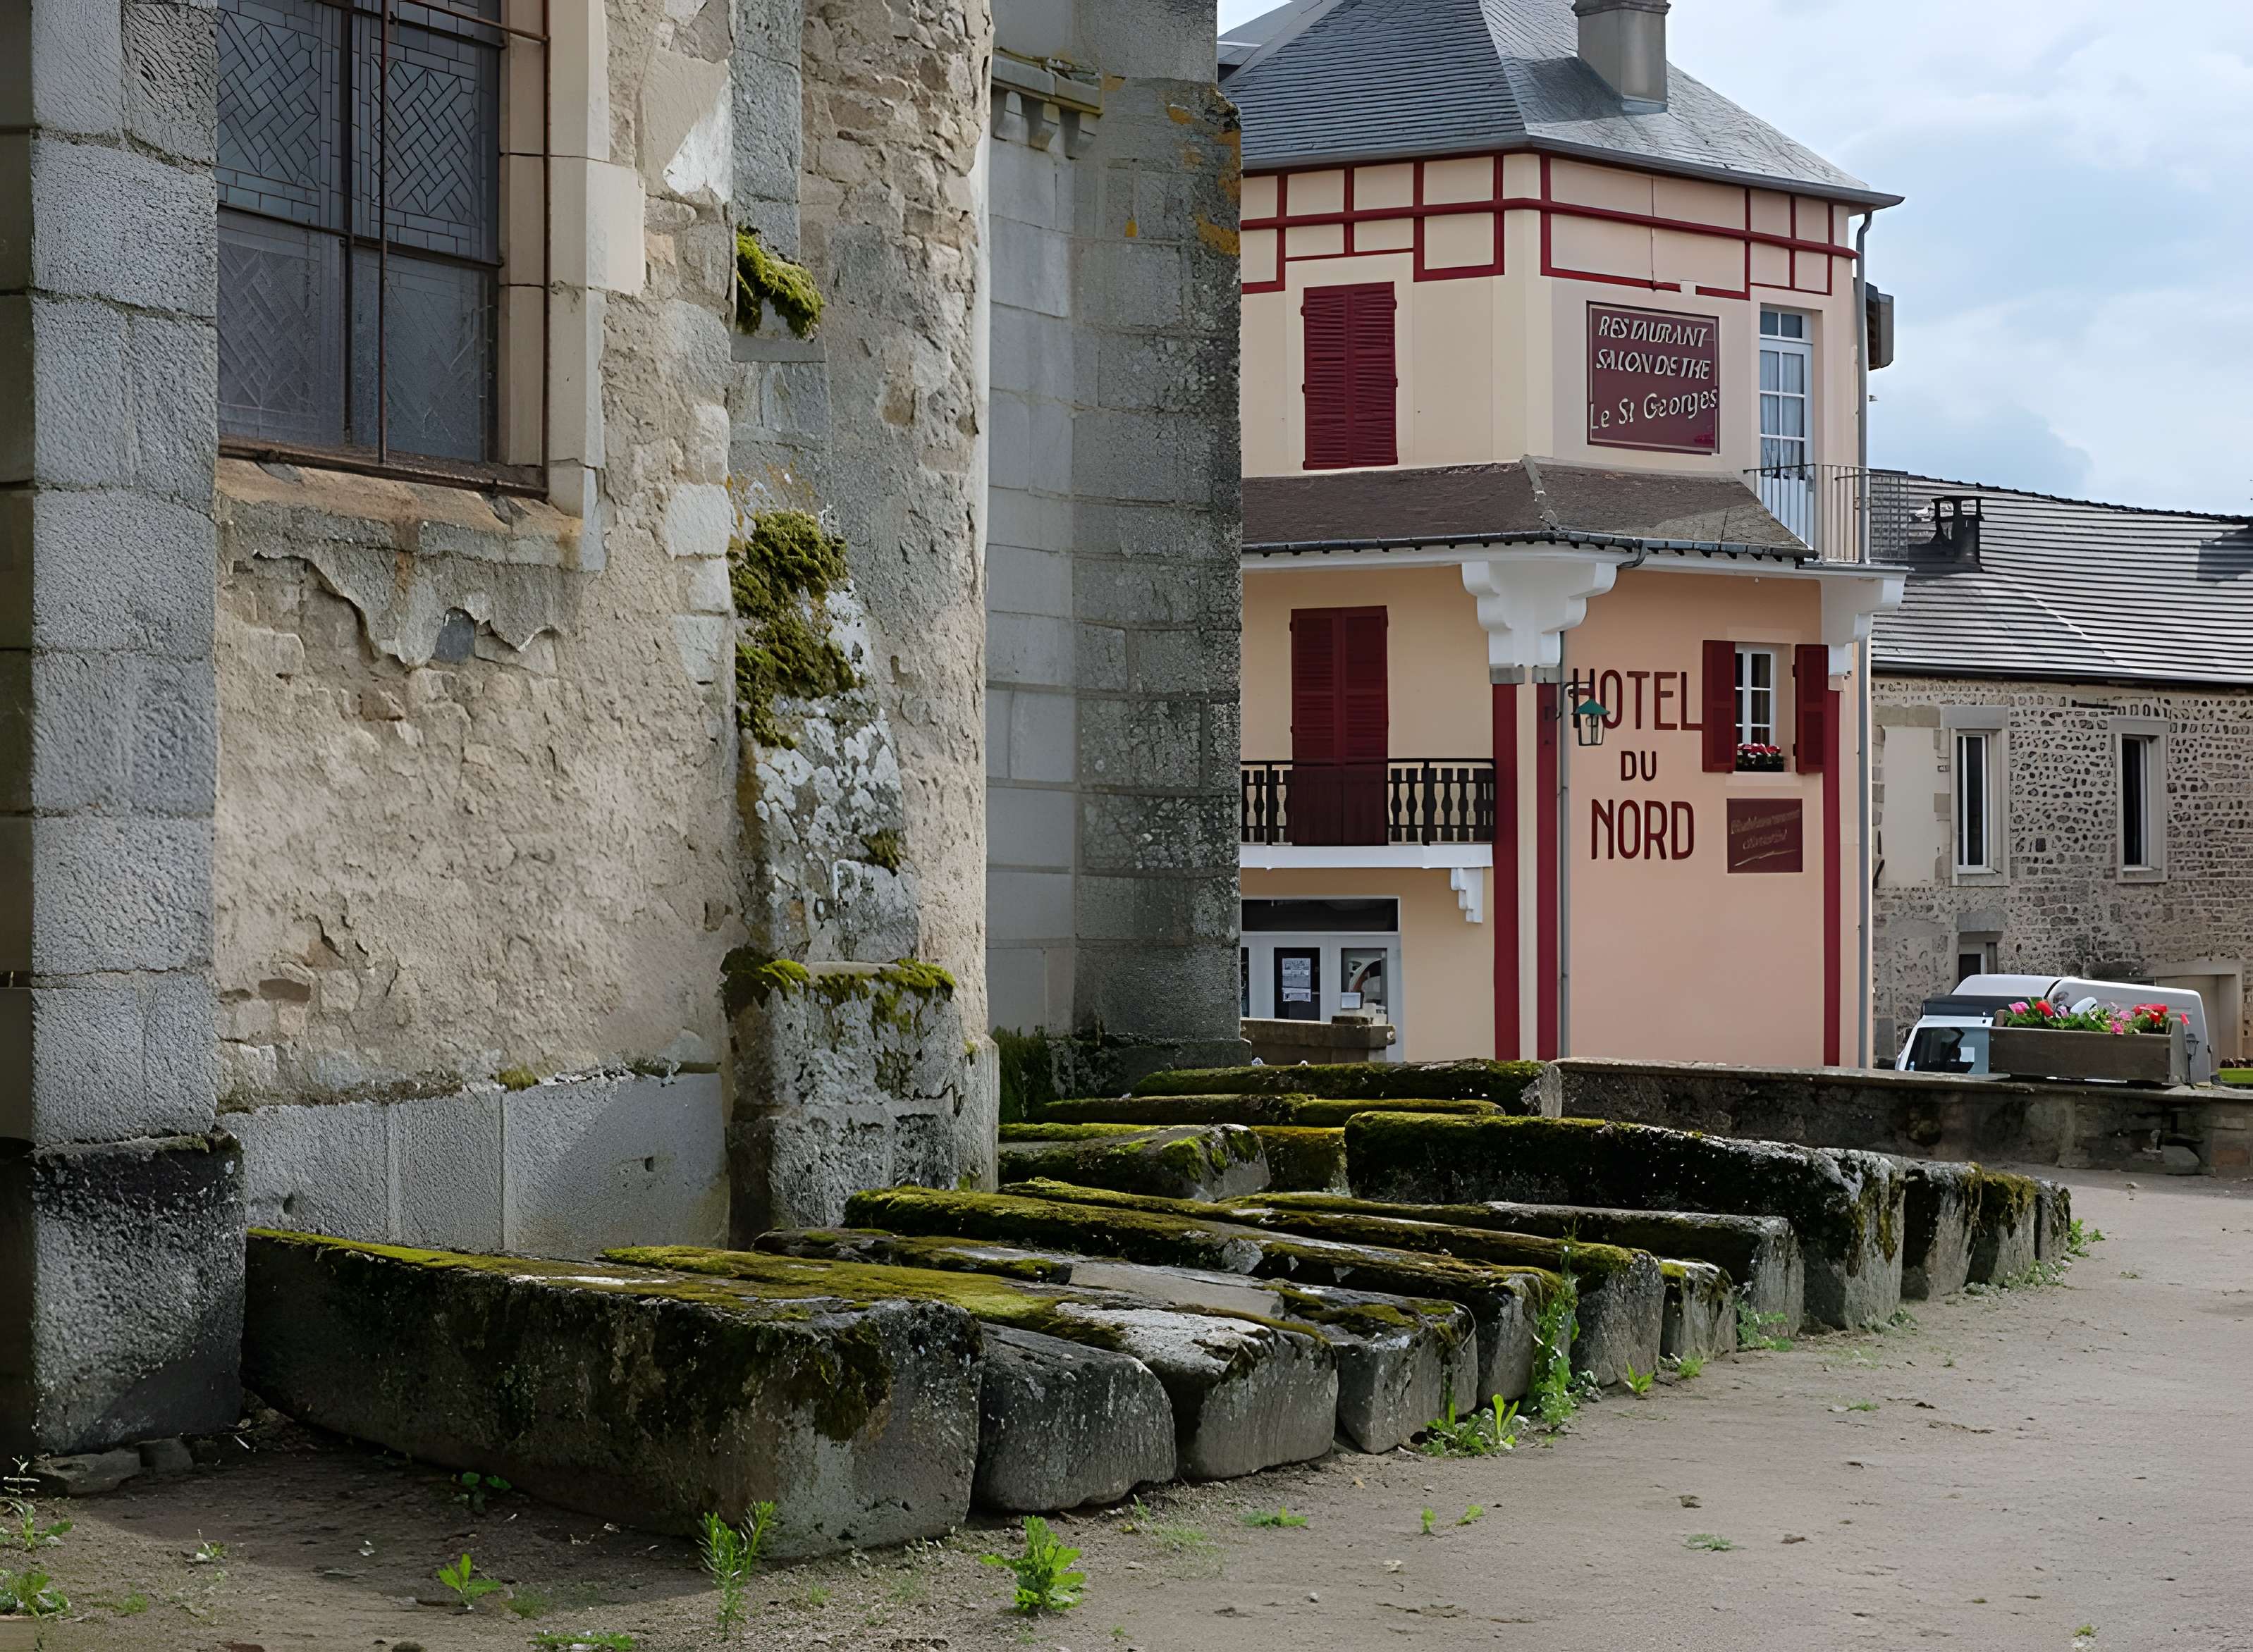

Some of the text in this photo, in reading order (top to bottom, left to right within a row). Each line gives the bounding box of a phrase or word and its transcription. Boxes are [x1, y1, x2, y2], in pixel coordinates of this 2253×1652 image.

[1598, 315, 1708, 347] RESTAURANT
[1595, 348, 1712, 380] SALON DE THE
[1590, 403, 1610, 429] Le
[1644, 388, 1718, 419] Georges
[1572, 667, 1703, 731] HOTEL
[1621, 751, 1657, 782] DU
[1591, 799, 1694, 861] NORD
